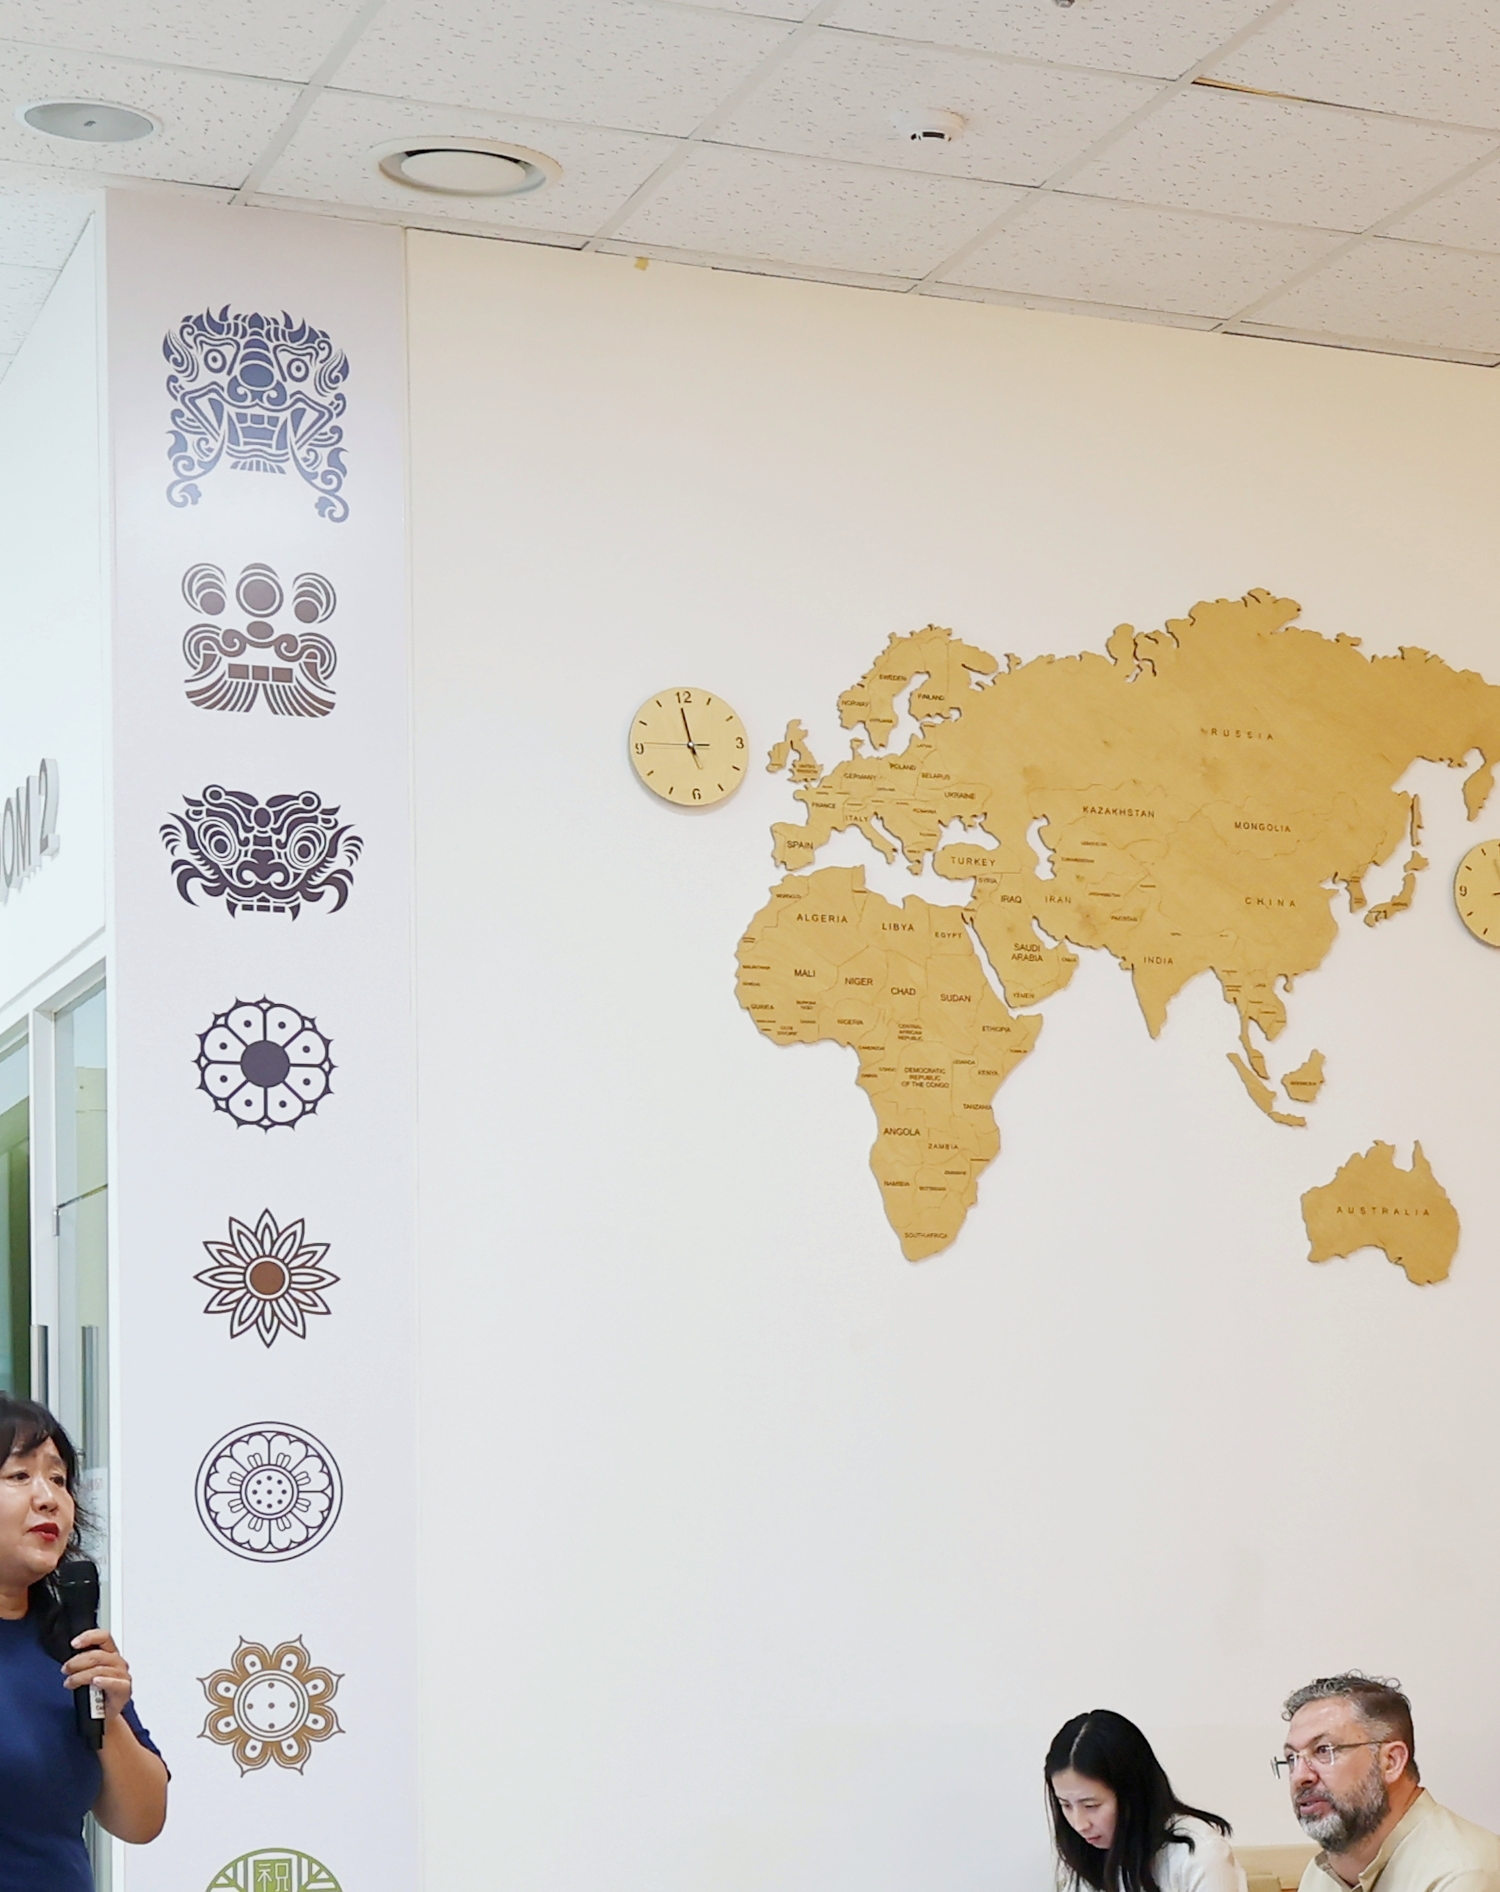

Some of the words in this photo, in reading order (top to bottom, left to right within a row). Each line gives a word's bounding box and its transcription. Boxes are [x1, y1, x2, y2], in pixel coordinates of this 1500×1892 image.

[675, 691, 692, 704] 12
[1211, 728, 1274, 740] RUSSIA
[735, 736, 745, 749] 3
[635, 742, 644, 755] 9
[844, 772, 877, 781] GERMANY
[921, 772, 950, 780] BELARUS
[692, 788, 702, 800] 6
[944, 792, 976, 800] UKRAINE
[38, 758, 60, 857] 2
[1082, 806, 1155, 818] KAZAKHSTAN
[845, 815, 868, 823] ITALY
[1234, 821, 1291, 833] MONGOLIA
[787, 840, 813, 849] SPAIN
[951, 856, 996, 866] TURKEY
[1459, 885, 1468, 897] 9
[1001, 895, 1022, 904] IRAQ
[1045, 895, 1072, 904] IRAN
[1245, 897, 1296, 907] CHINA
[797, 914, 848, 923] ALGERIA
[882, 923, 915, 931] LIBYA
[935, 931, 962, 939] EGYPT
[1014, 943, 1041, 952] SAUDI
[1011, 953, 1043, 962] ARABIA
[1143, 957, 1174, 965] INDIA
[794, 969, 816, 977] MALI
[845, 977, 873, 986] NIGER
[891, 987, 916, 996] CHAD
[941, 993, 971, 1003] SUDAN
[904, 1067, 946, 1075] DEMOCRATIC
[926, 1081, 950, 1089] CONGO
[883, 1127, 921, 1137] ANGOLA
[1336, 1206, 1430, 1217] AUSTRALIA
